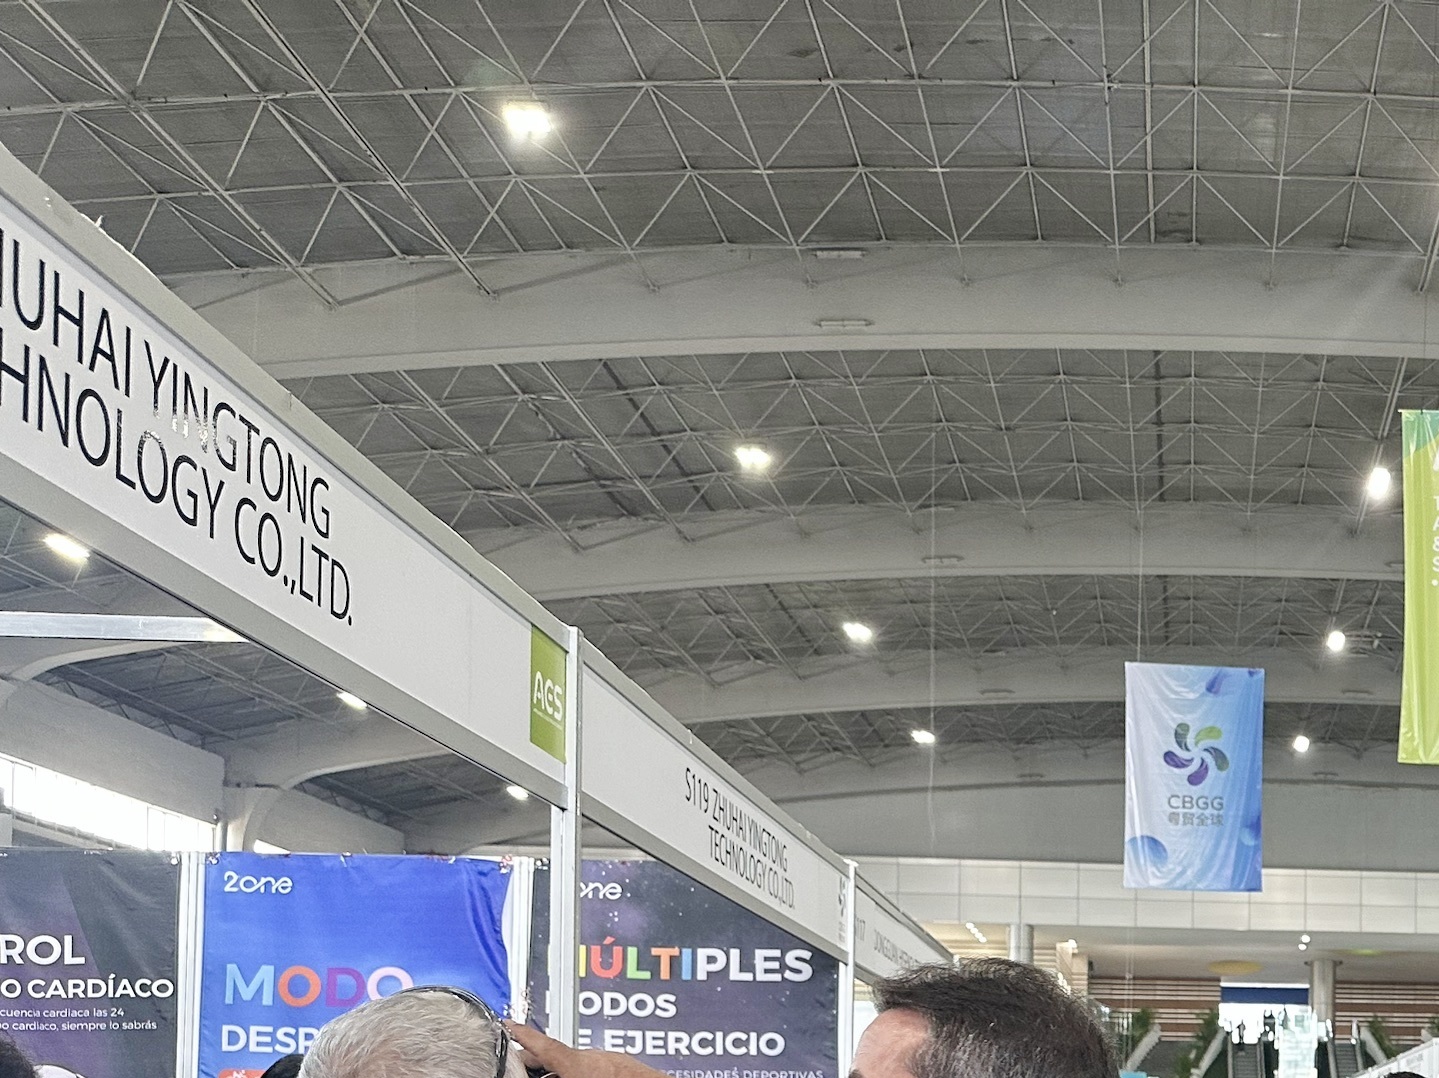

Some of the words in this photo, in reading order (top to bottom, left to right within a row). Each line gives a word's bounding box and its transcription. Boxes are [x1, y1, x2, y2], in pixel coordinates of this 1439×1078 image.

[0, 228, 131, 398] UHAI
[144, 339, 330, 539] YINGTONG
[234, 497, 352, 626] CO.,LTD.
[1168, 794, 1224, 811] CBGG
[685, 767, 709, 813] S119
[712, 788, 747, 843] ZHUHAI
[747, 815, 788, 873] YINGTONG
[708, 825, 767, 892] TECHNOLOGY
[0, 934, 86, 965] ROL
[560, 936, 813, 982] ÚLTIPLES
[27, 973, 174, 998] CARDÍACO
[225, 964, 414, 1008] MODO
[93, 1008, 107, 1018] las
[111, 1008, 124, 1017] 24
[578, 991, 677, 1018] ODOS
[61, 1021, 106, 1032] siempre
[110, 1021, 119, 1030] lo
[122, 1021, 157, 1030] sabrás
[604, 1029, 785, 1057] EJERCICIO
